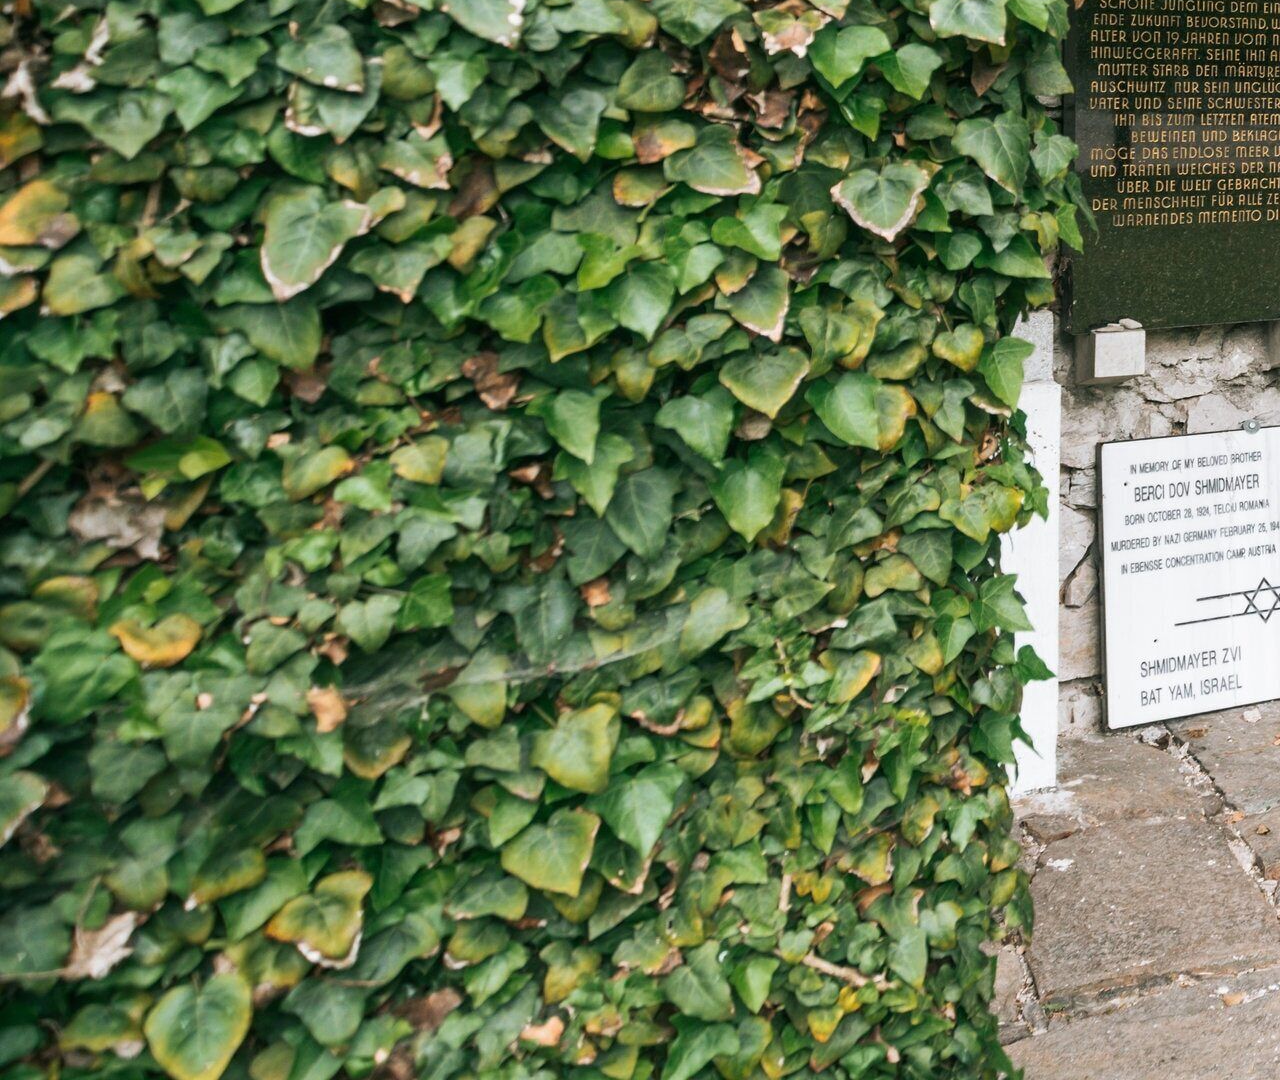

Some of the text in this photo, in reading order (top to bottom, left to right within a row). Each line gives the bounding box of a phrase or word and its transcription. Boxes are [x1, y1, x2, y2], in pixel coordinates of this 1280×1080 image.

[1094, 14, 1124, 26] ENDE
[1131, 15, 1180, 27] ZUKUNFT
[1231, 1, 1258, 13] DEM
[1091, 81, 1166, 93] AUSCHWITZ
[1175, 81, 1199, 93] NUR
[1204, 81, 1229, 93] SEIN
[1113, 213, 1192, 226] WARNENDES
[1199, 211, 1261, 223] MEMENTO
[1130, 451, 1262, 474] IN MEMORY OF MY BELOVED BROTHER
[1134, 474, 1260, 502] BERCI DOV SHMIDMAYER
[1125, 499, 1269, 526] BORN OCTOBER TELCIU ROMANIA
[1111, 538, 1150, 552] MURDERED
[1153, 536, 1161, 547] BY
[1165, 534, 1180, 545] NAZI
[1183, 529, 1217, 543] GERMANY
[1220, 525, 1256, 539] FEBRUARY
[1131, 545, 1276, 574] EBENSSE CONCENTRATION AUSTRIA
[1140, 646, 1242, 677] SHMIDMAYER ZVI
[1141, 675, 1242, 706] BAT ISRAEL
